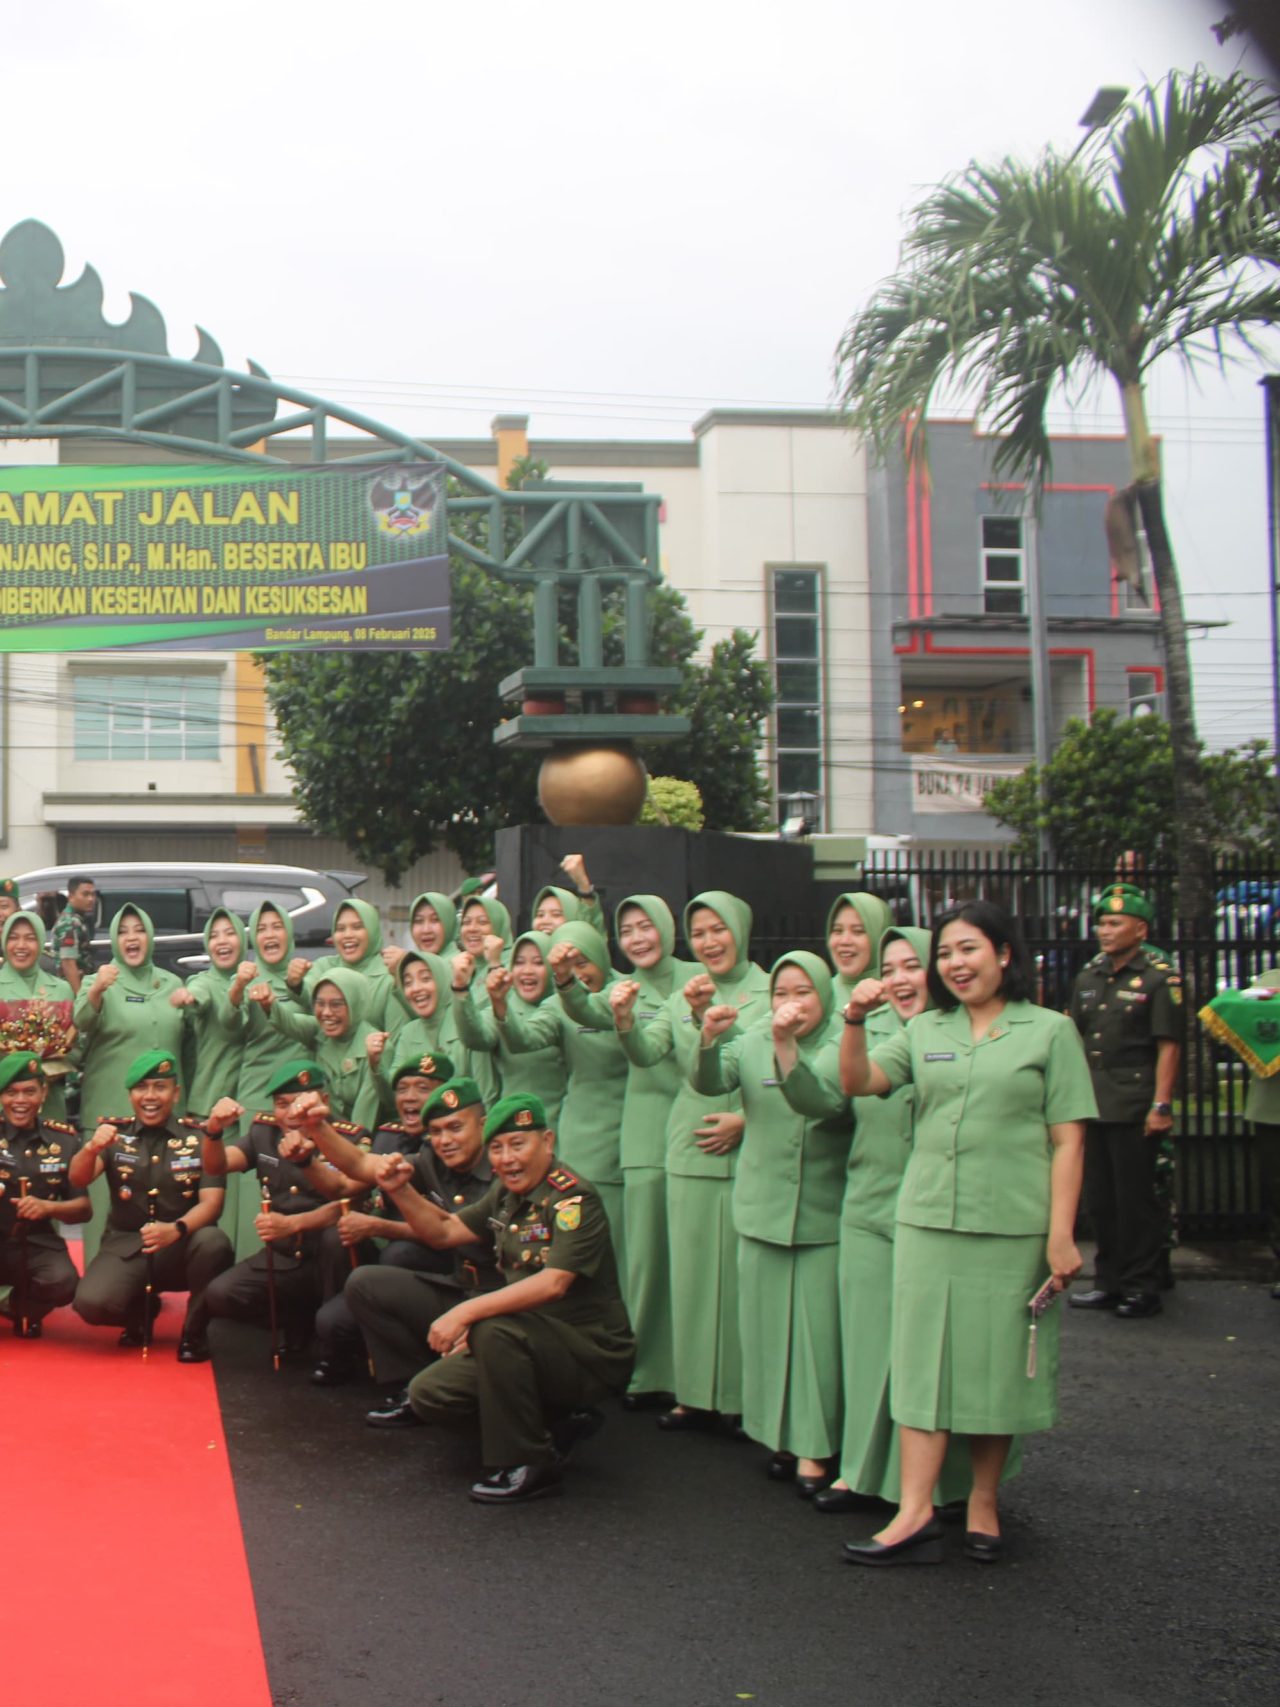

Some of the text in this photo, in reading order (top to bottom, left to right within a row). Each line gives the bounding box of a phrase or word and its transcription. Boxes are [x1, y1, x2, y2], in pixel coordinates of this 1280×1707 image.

[138, 491, 299, 525] JALAN
[83, 542, 141, 575] S.I.P.,
[147, 542, 218, 571] M.Han.
[223, 542, 325, 571] BESERTA
[329, 542, 367, 571] IBU
[91, 586, 198, 614] KESEHATAN
[202, 586, 240, 614] DAN
[244, 585, 367, 614] KESUKSESAN
[265, 628, 301, 640] Bandar
[303, 628, 352, 642] Lampung,
[369, 627, 411, 640] Februari
